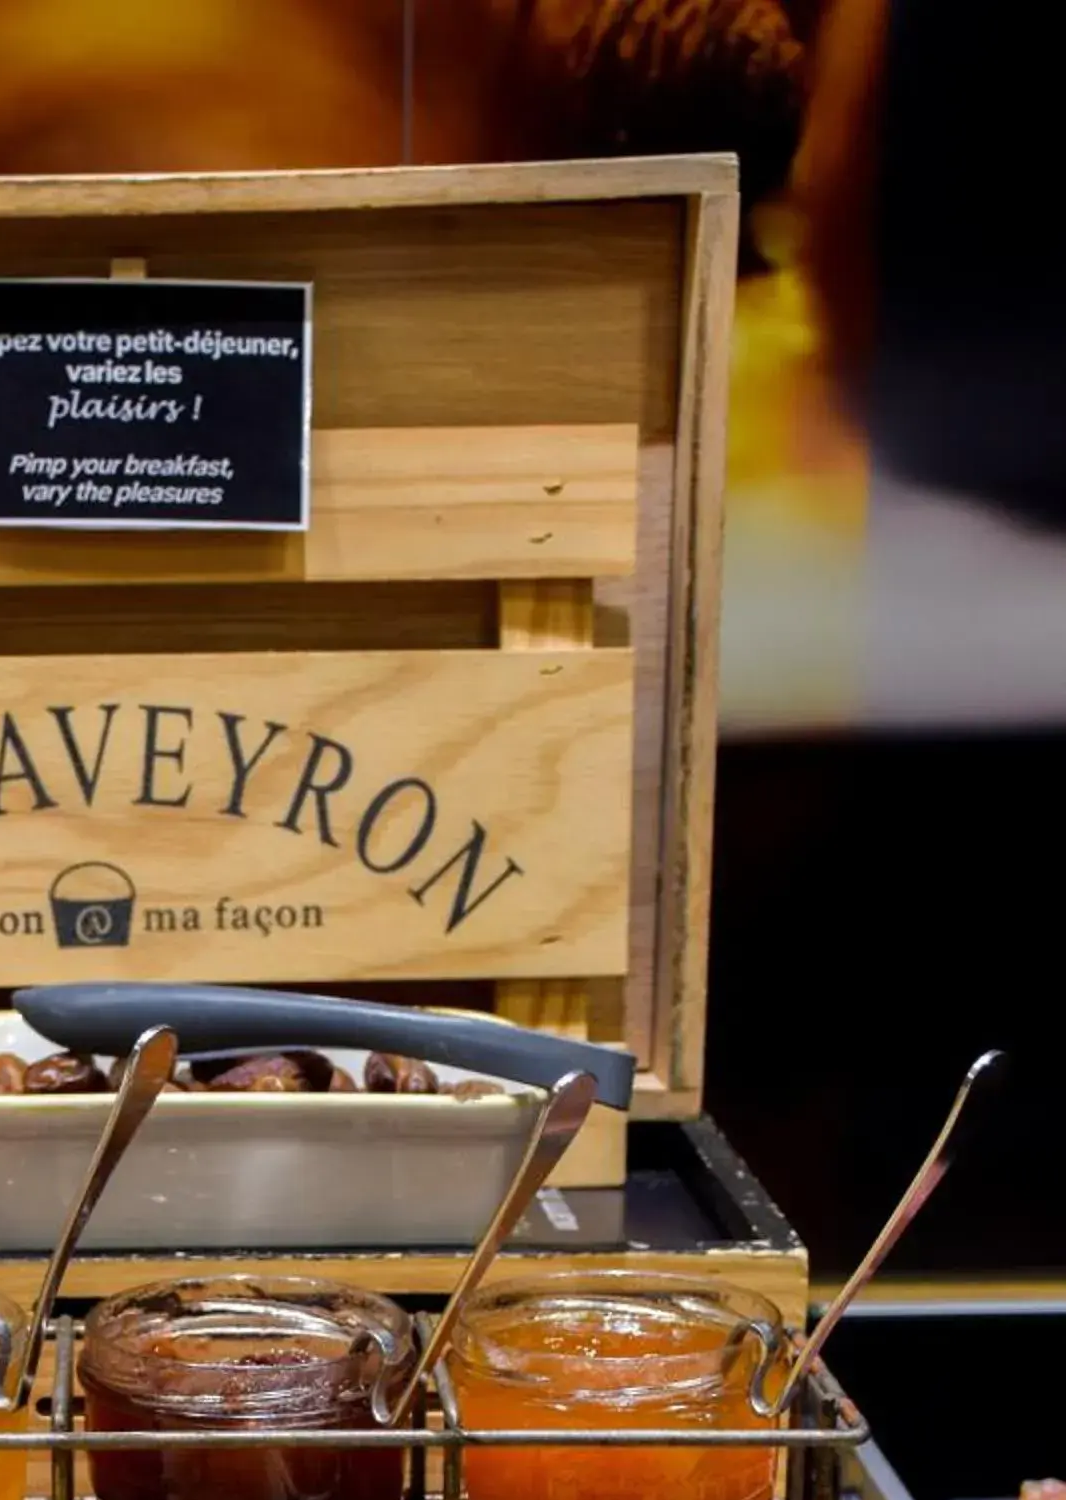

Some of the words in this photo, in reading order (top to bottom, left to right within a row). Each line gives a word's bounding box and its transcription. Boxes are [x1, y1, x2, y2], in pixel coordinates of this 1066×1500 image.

[47, 331, 112, 352] votre
[115, 330, 299, 359] petit-déjeuner,
[65, 360, 142, 383] variez
[144, 360, 183, 384] les
[47, 391, 185, 428] plaisirs
[9, 453, 67, 480] Pimp
[70, 458, 123, 480] your
[123, 453, 234, 480] breakfast,
[21, 483, 72, 507] vary
[75, 480, 113, 501] the
[113, 481, 225, 507] pleasures
[142, 906, 201, 932] ma
[214, 896, 324, 938] façon
